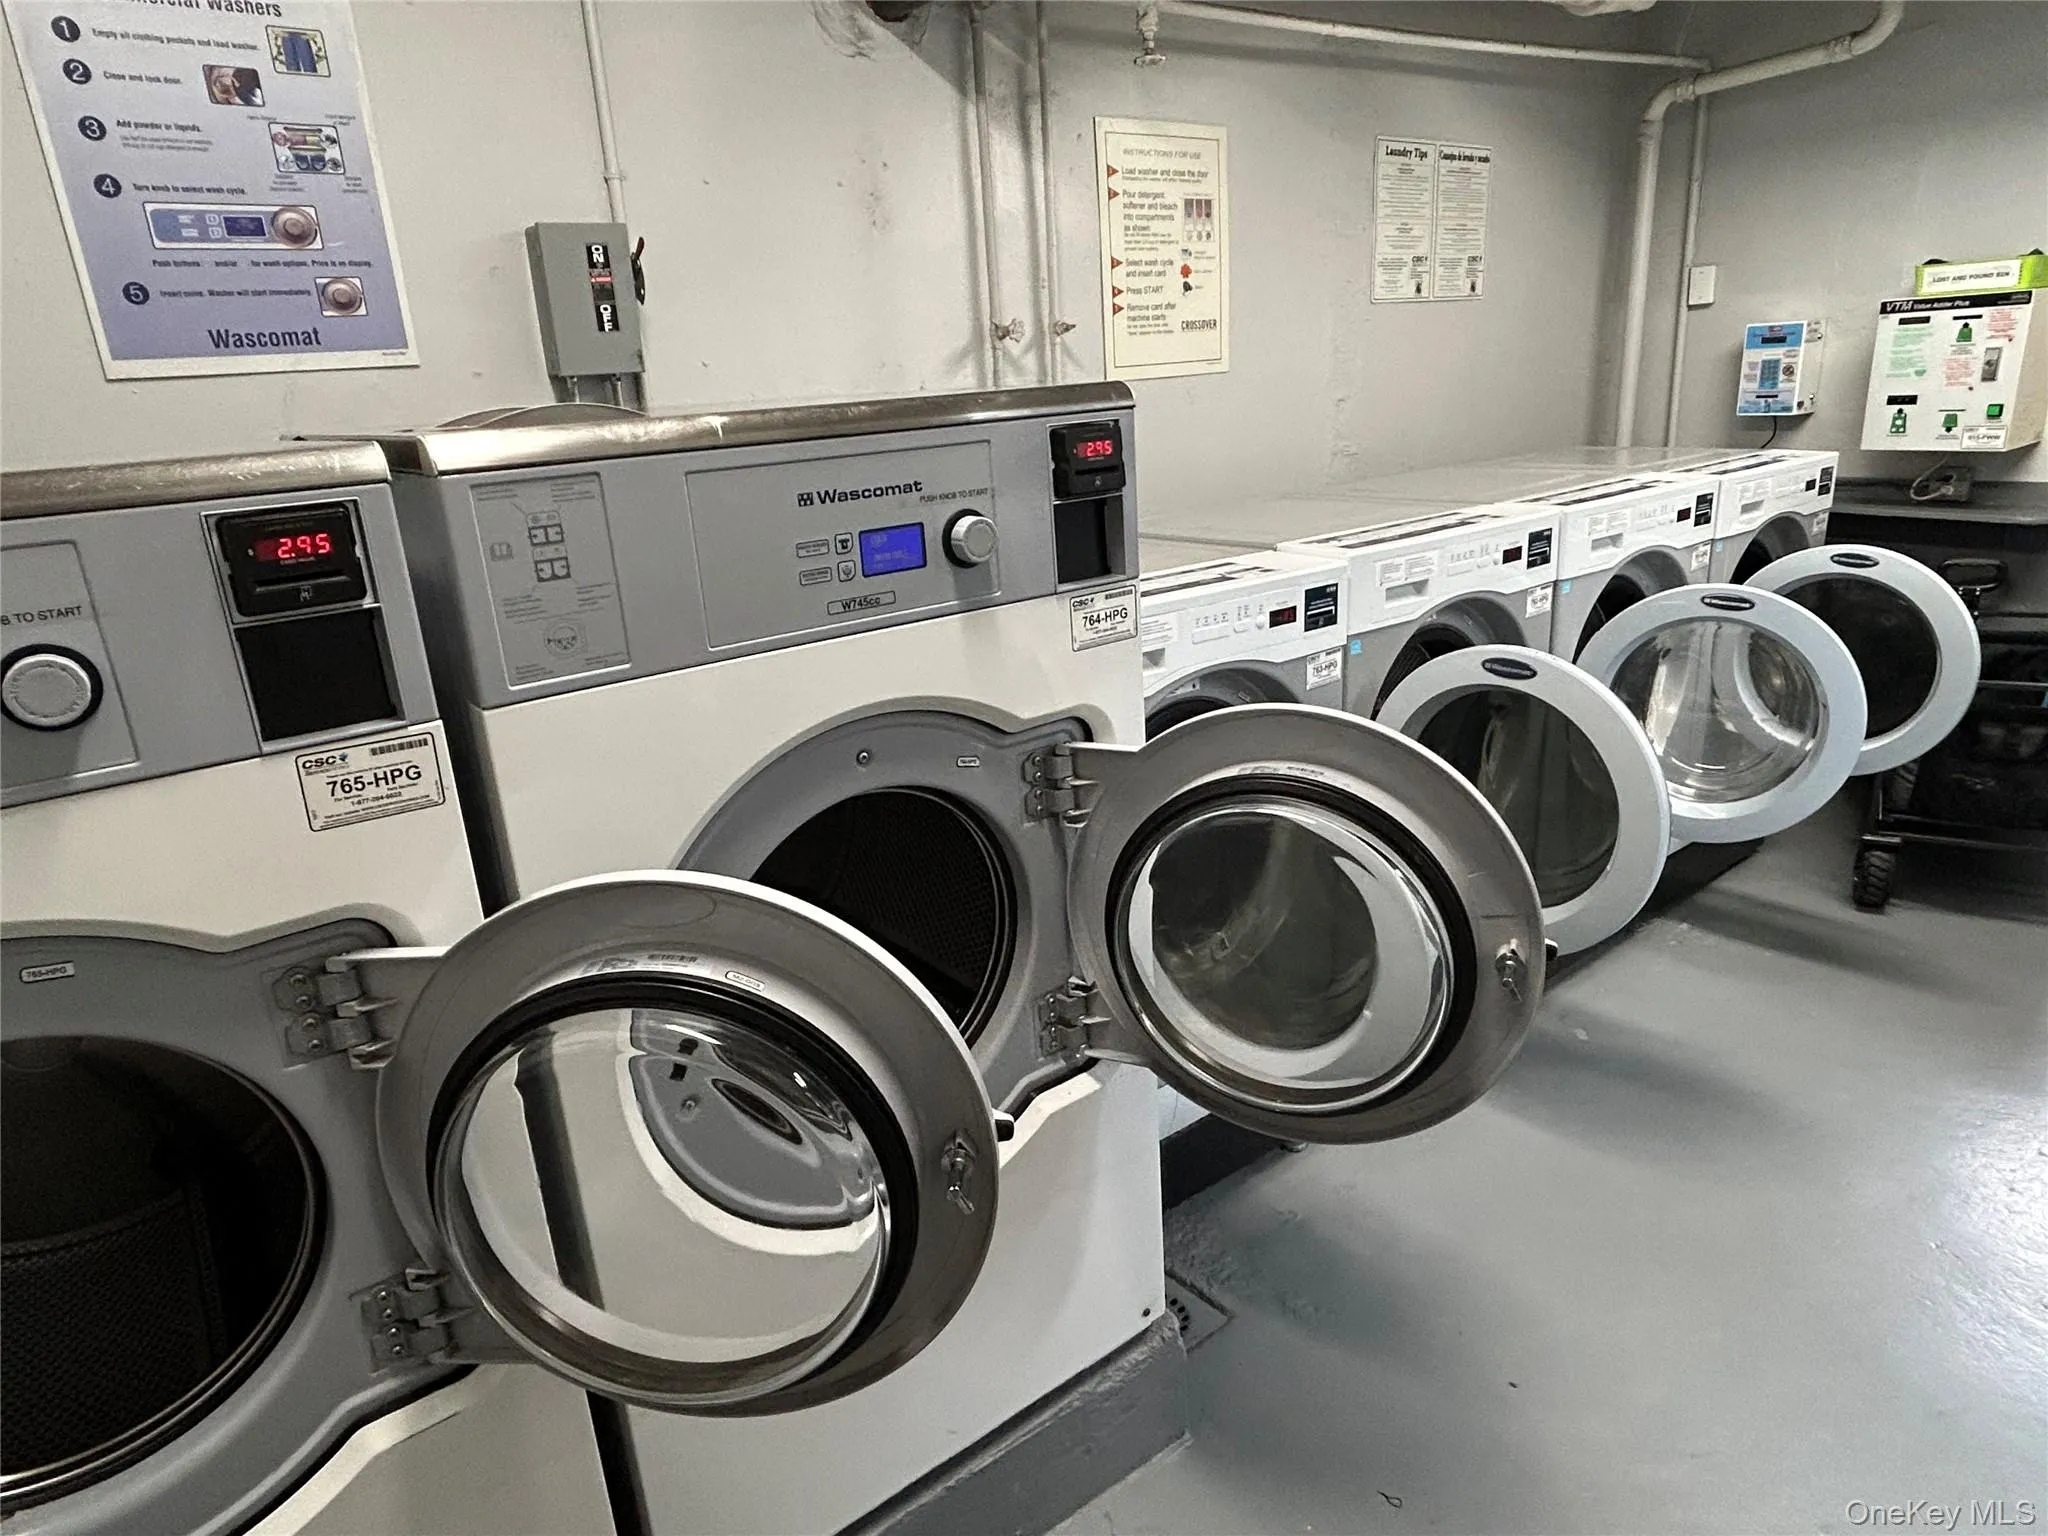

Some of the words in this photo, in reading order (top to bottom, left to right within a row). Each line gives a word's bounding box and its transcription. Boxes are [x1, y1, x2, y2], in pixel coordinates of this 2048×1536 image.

[208, 0, 282, 17] Washers
[92, 28, 117, 40] Empty
[197, 39, 210, 47] and
[212, 40, 229, 49] load
[104, 71, 126, 80] Close
[129, 74, 143, 82] and
[144, 75, 161, 83] lock
[116, 119, 131, 128] Add
[133, 121, 162, 130] powder
[1385, 145, 1412, 160] Laundry
[1414, 148, 1428, 161] Tips
[1121, 166, 1136, 175] Load
[1160, 168, 1171, 176] and
[133, 183, 150, 192] Turn
[151, 184, 170, 192] knob
[1122, 189, 1136, 199] Pour
[1147, 202, 1157, 210] and
[1124, 213, 1133, 221] into
[591, 245, 604, 262] ON
[1126, 269, 1136, 277] and
[1154, 269, 1166, 277] card
[1126, 286, 1142, 295] Press
[1144, 285, 1164, 294] START
[1127, 303, 1149, 312] Remove
[1151, 302, 1163, 311] card
[1886, 301, 1912, 313] VTM
[600, 304, 613, 332] OFF
[1181, 319, 1217, 331] CROSSOVER
[208, 327, 321, 349] Wascomat
[817, 480, 923, 504] Wascomat
[920, 494, 937, 503] PUSH
[939, 491, 957, 501] KNOB
[959, 490, 967, 498] TO
[968, 487, 988, 498] START
[277, 533, 330, 559] 2.95
[13, 612, 34, 622] TO
[38, 605, 82, 621] START
[1082, 607, 1128, 627] 764-HPG
[302, 755, 337, 770] CSC
[326, 765, 422, 797] 765-HPG
